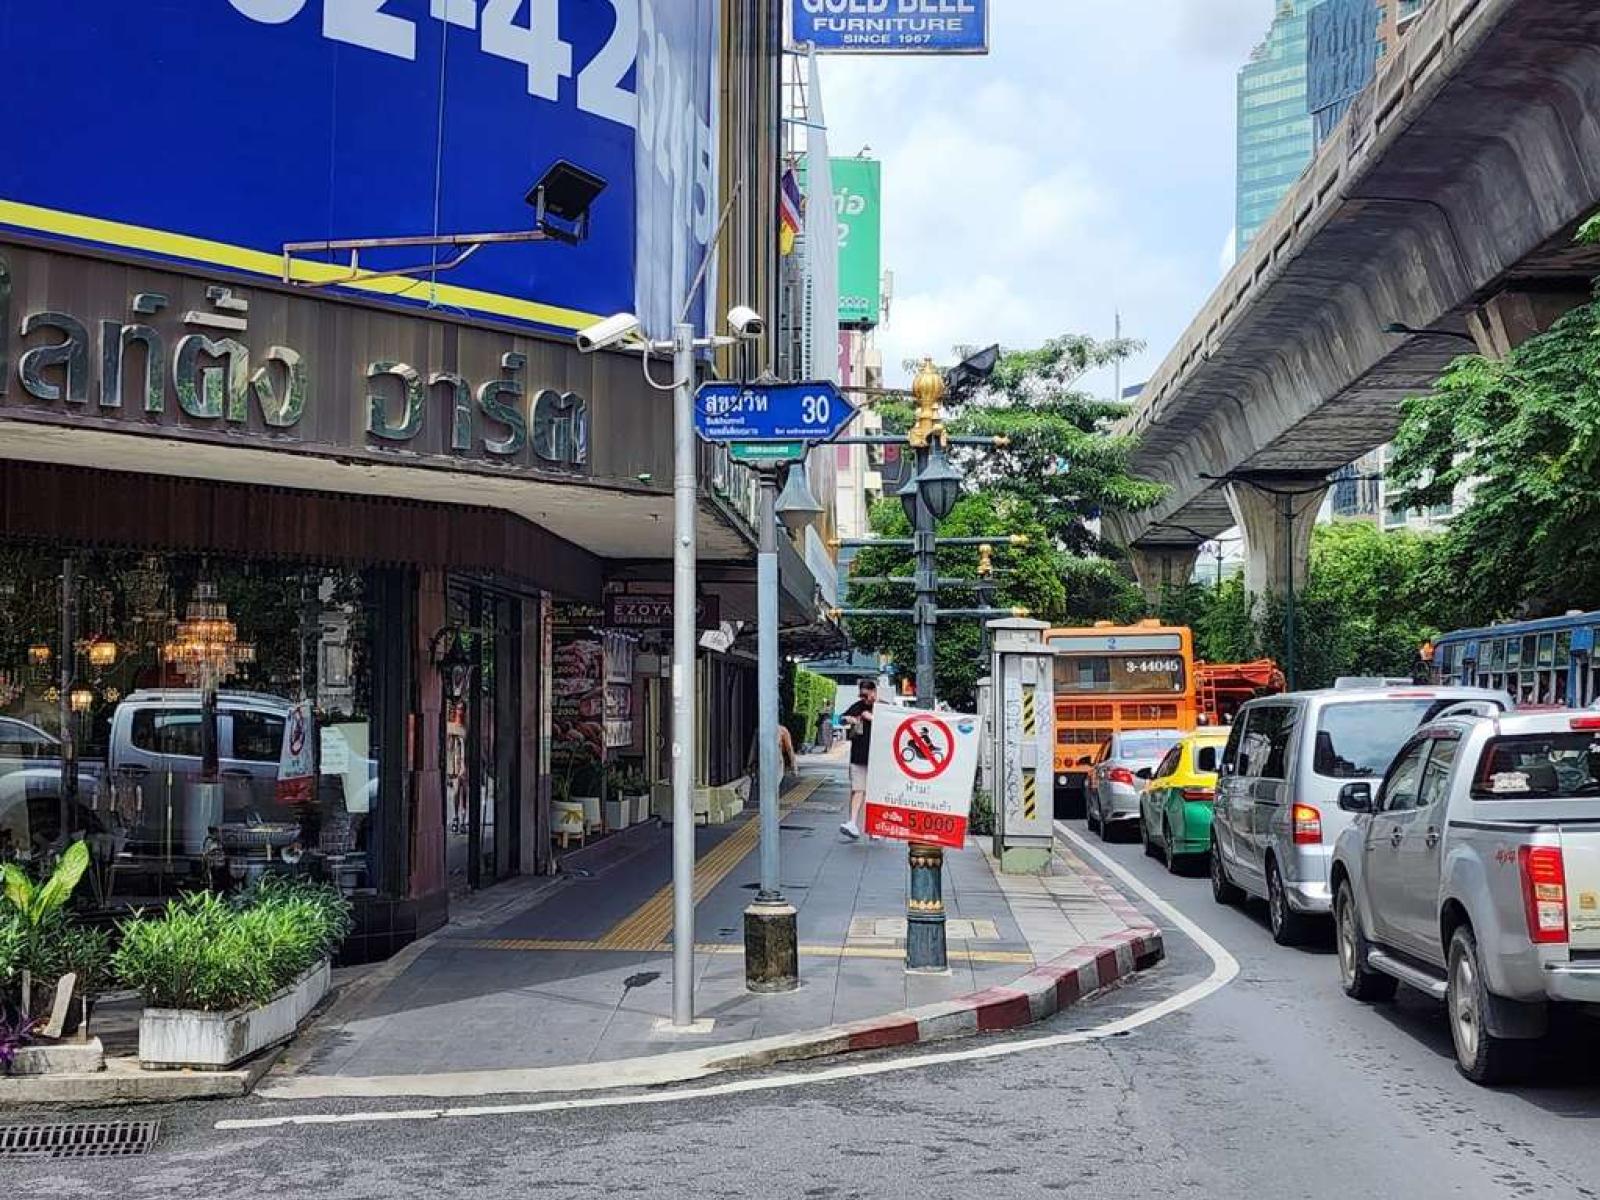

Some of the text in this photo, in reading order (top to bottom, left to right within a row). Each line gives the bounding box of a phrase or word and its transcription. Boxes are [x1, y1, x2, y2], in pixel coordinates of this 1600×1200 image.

[813, 18, 963, 31] FURNITURE
[843, 34, 890, 43] SINCE
[801, 395, 830, 425] 30
